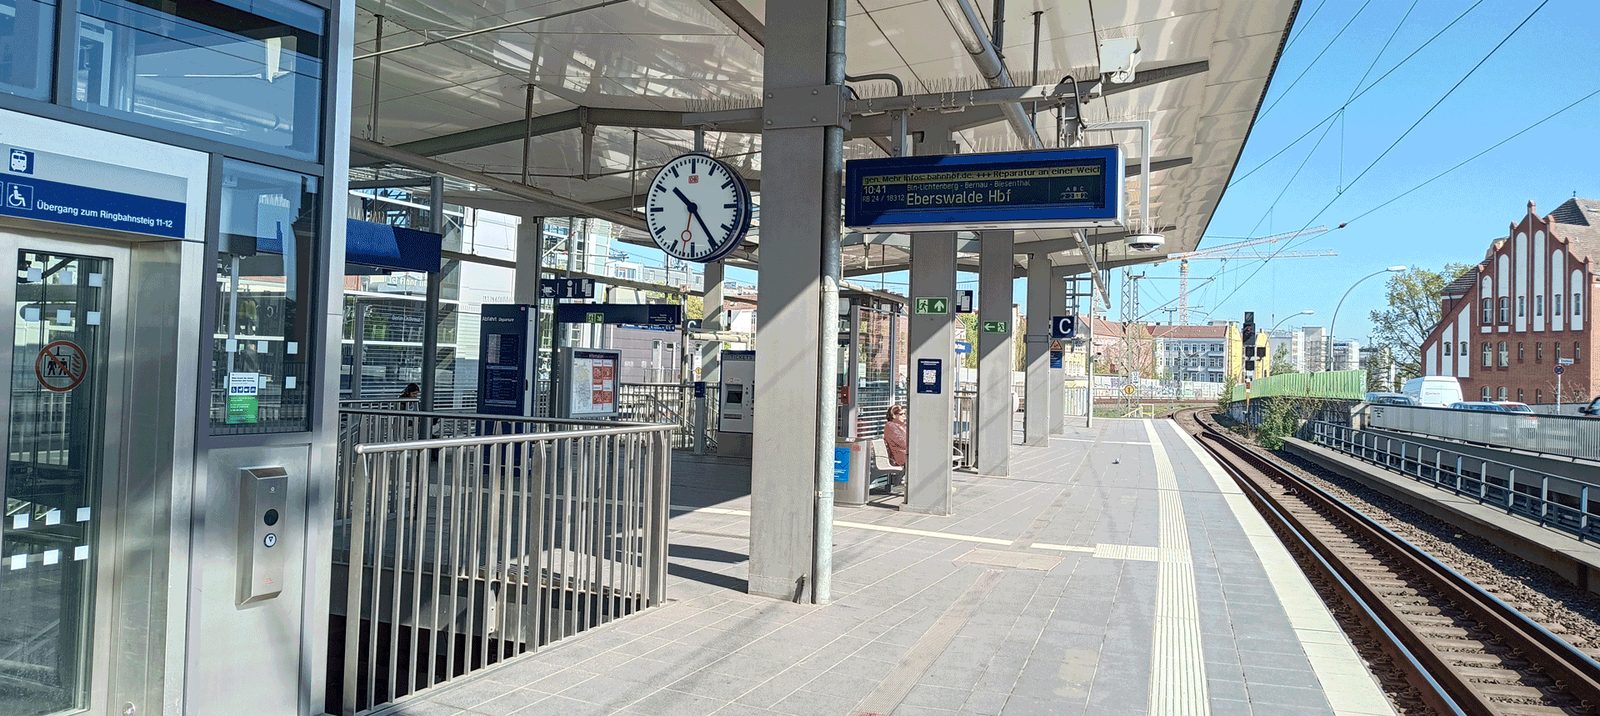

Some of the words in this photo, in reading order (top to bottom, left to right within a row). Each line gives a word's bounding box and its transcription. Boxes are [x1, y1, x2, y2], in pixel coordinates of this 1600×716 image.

[882, 175, 901, 183] Mehr
[993, 169, 1036, 178] Reparatur
[863, 186, 886, 195] 10:41
[994, 180, 1031, 188] Biesenthal
[907, 191, 983, 206] Eberswalde
[988, 189, 1012, 203] Hbf
[36, 200, 78, 217] Übergang
[80, 208, 98, 218] zum
[100, 210, 155, 227] Ringbahnsteig
[156, 218, 173, 229] 11-12
[1059, 318, 1071, 334] C
